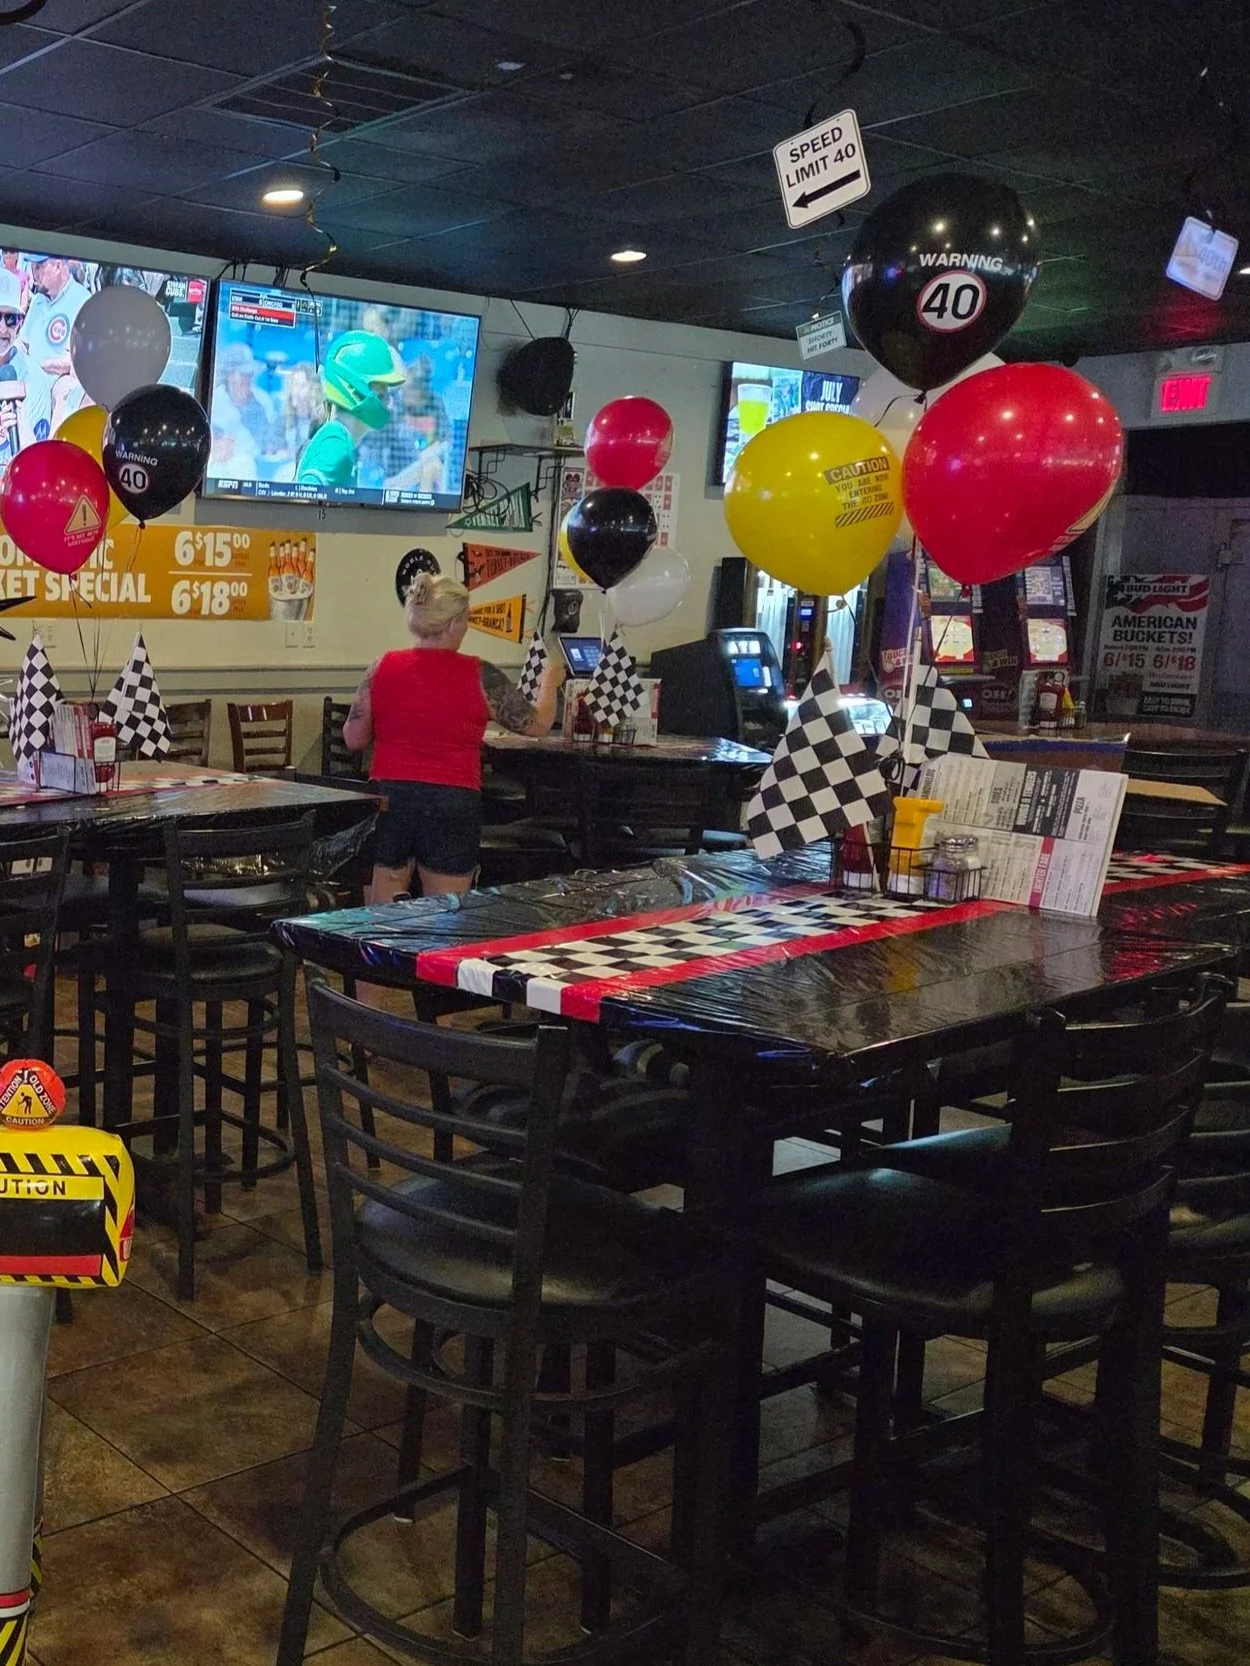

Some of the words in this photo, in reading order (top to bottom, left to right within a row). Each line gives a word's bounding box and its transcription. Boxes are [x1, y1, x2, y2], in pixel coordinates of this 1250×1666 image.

[790, 126, 842, 163] SPEED
[786, 155, 828, 188] LIMIT
[833, 143, 856, 163] 40
[919, 253, 1003, 271] WARNING
[922, 283, 980, 320] 40
[820, 380, 843, 403] JULY
[115, 450, 158, 466] WARNING
[831, 458, 888, 480] CAUTION
[120, 468, 146, 490] 40
[44, 568, 151, 603] SPECIAL
[1127, 584, 1150, 594] BUD
[1153, 585, 1188, 594] LIGHT
[1111, 615, 1198, 630] AMERICAN
[1113, 629, 1193, 645] BUCKETS!
[1074, 797, 1086, 814] PIZZA
[29, 1075, 44, 1094] OLD
[40, 1092, 57, 1115] ZONE
[6, 1116, 44, 1126] CAUTION
